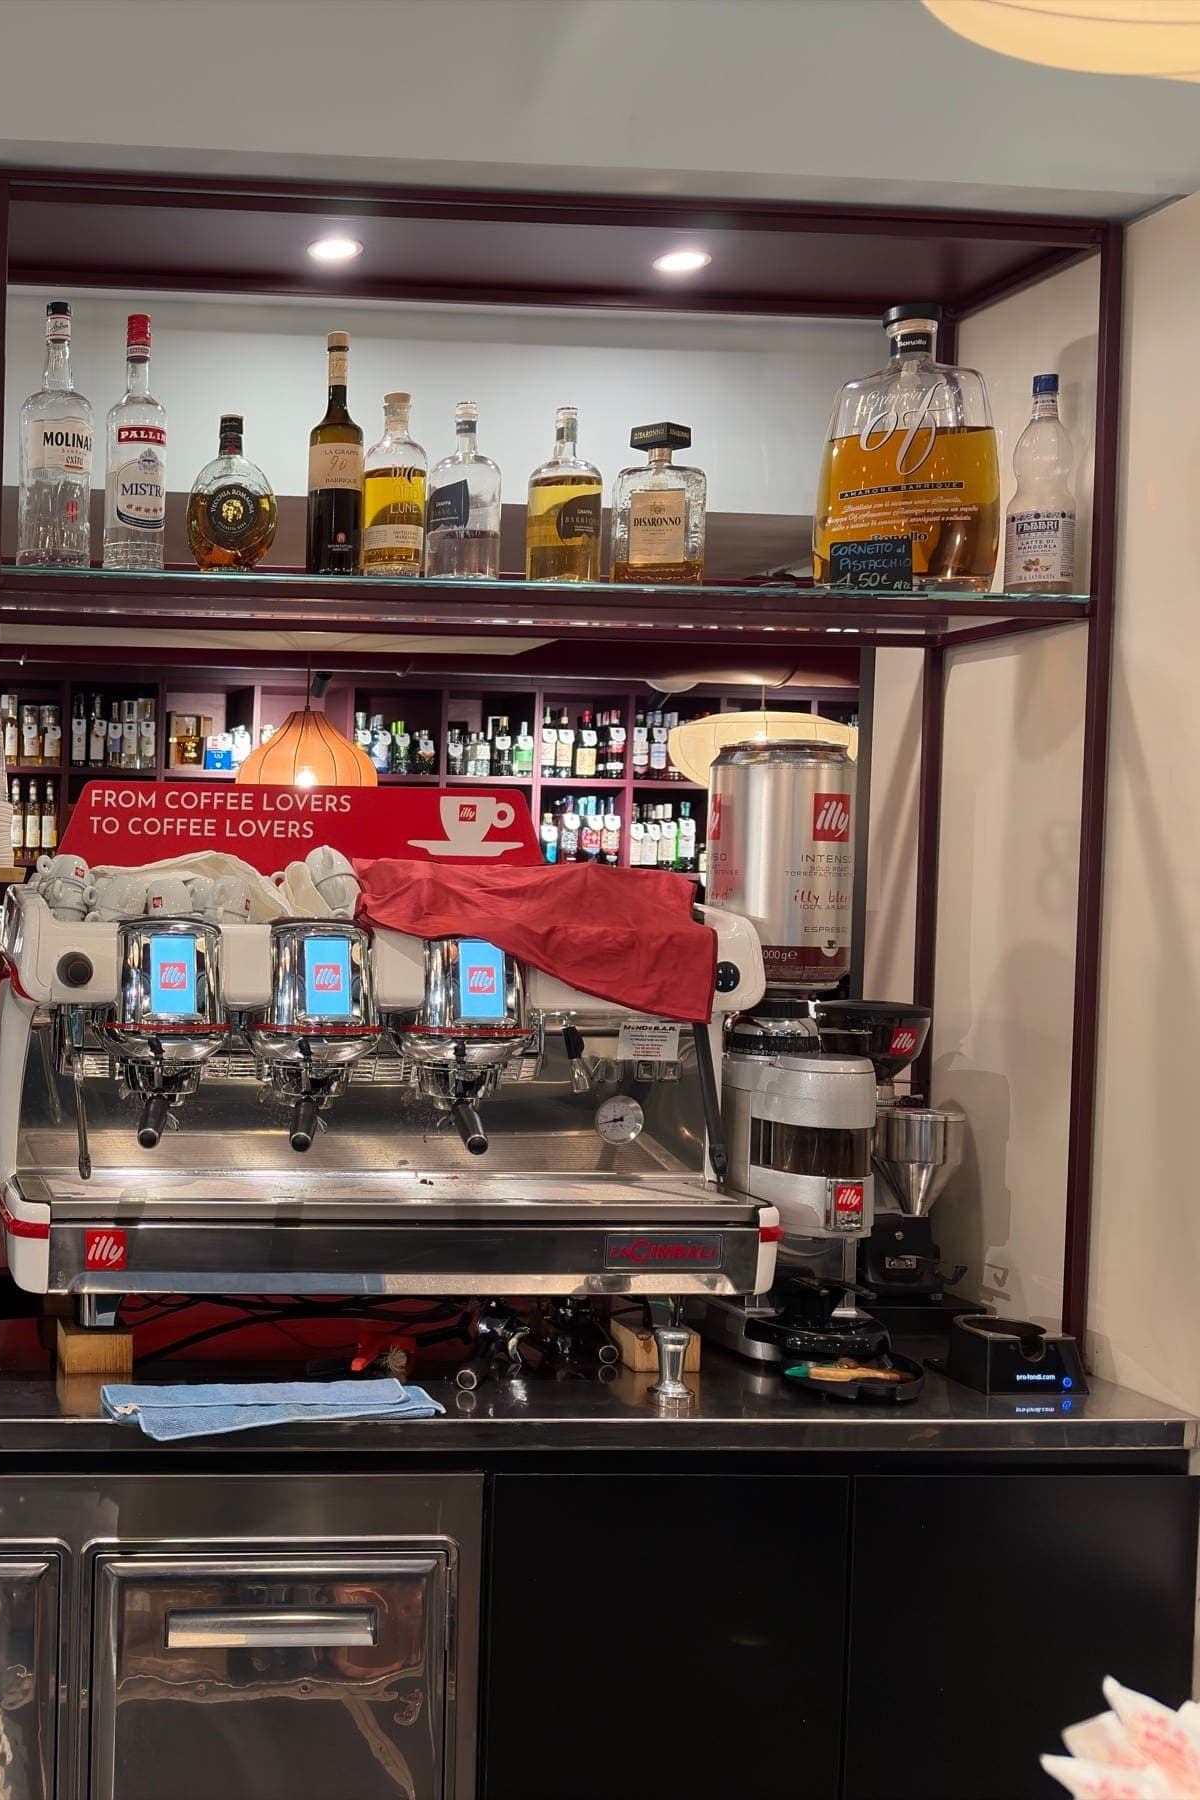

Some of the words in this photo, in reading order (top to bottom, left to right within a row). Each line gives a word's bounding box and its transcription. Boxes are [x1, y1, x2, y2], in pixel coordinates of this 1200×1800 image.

[121, 483, 163, 498] MISTR
[844, 486, 894, 498] AMARONE
[900, 482, 959, 491] BARRIQUE
[390, 502, 419, 514] LUNE
[633, 517, 681, 528] DISARONNO
[1018, 521, 1058, 532] FABBRI
[831, 543, 893, 556] CORNETTO
[839, 557, 912, 571] PISTACCHIO
[90, 790, 156, 809] FROM
[165, 791, 254, 811] COFFEE
[262, 793, 352, 813] LOVERS
[459, 807, 476, 821] illy
[816, 800, 849, 837] illy
[90, 816, 120, 835] TO
[128, 817, 217, 837] COFFEE
[225, 819, 315, 839] LOVERS
[794, 890, 819, 905] illy
[161, 966, 186, 987] illy
[315, 967, 341, 990] illy
[469, 969, 494, 991] illy
[892, 1032, 916, 1053] illy
[838, 1189, 861, 1208] illy
[88, 1235, 124, 1267] illy
